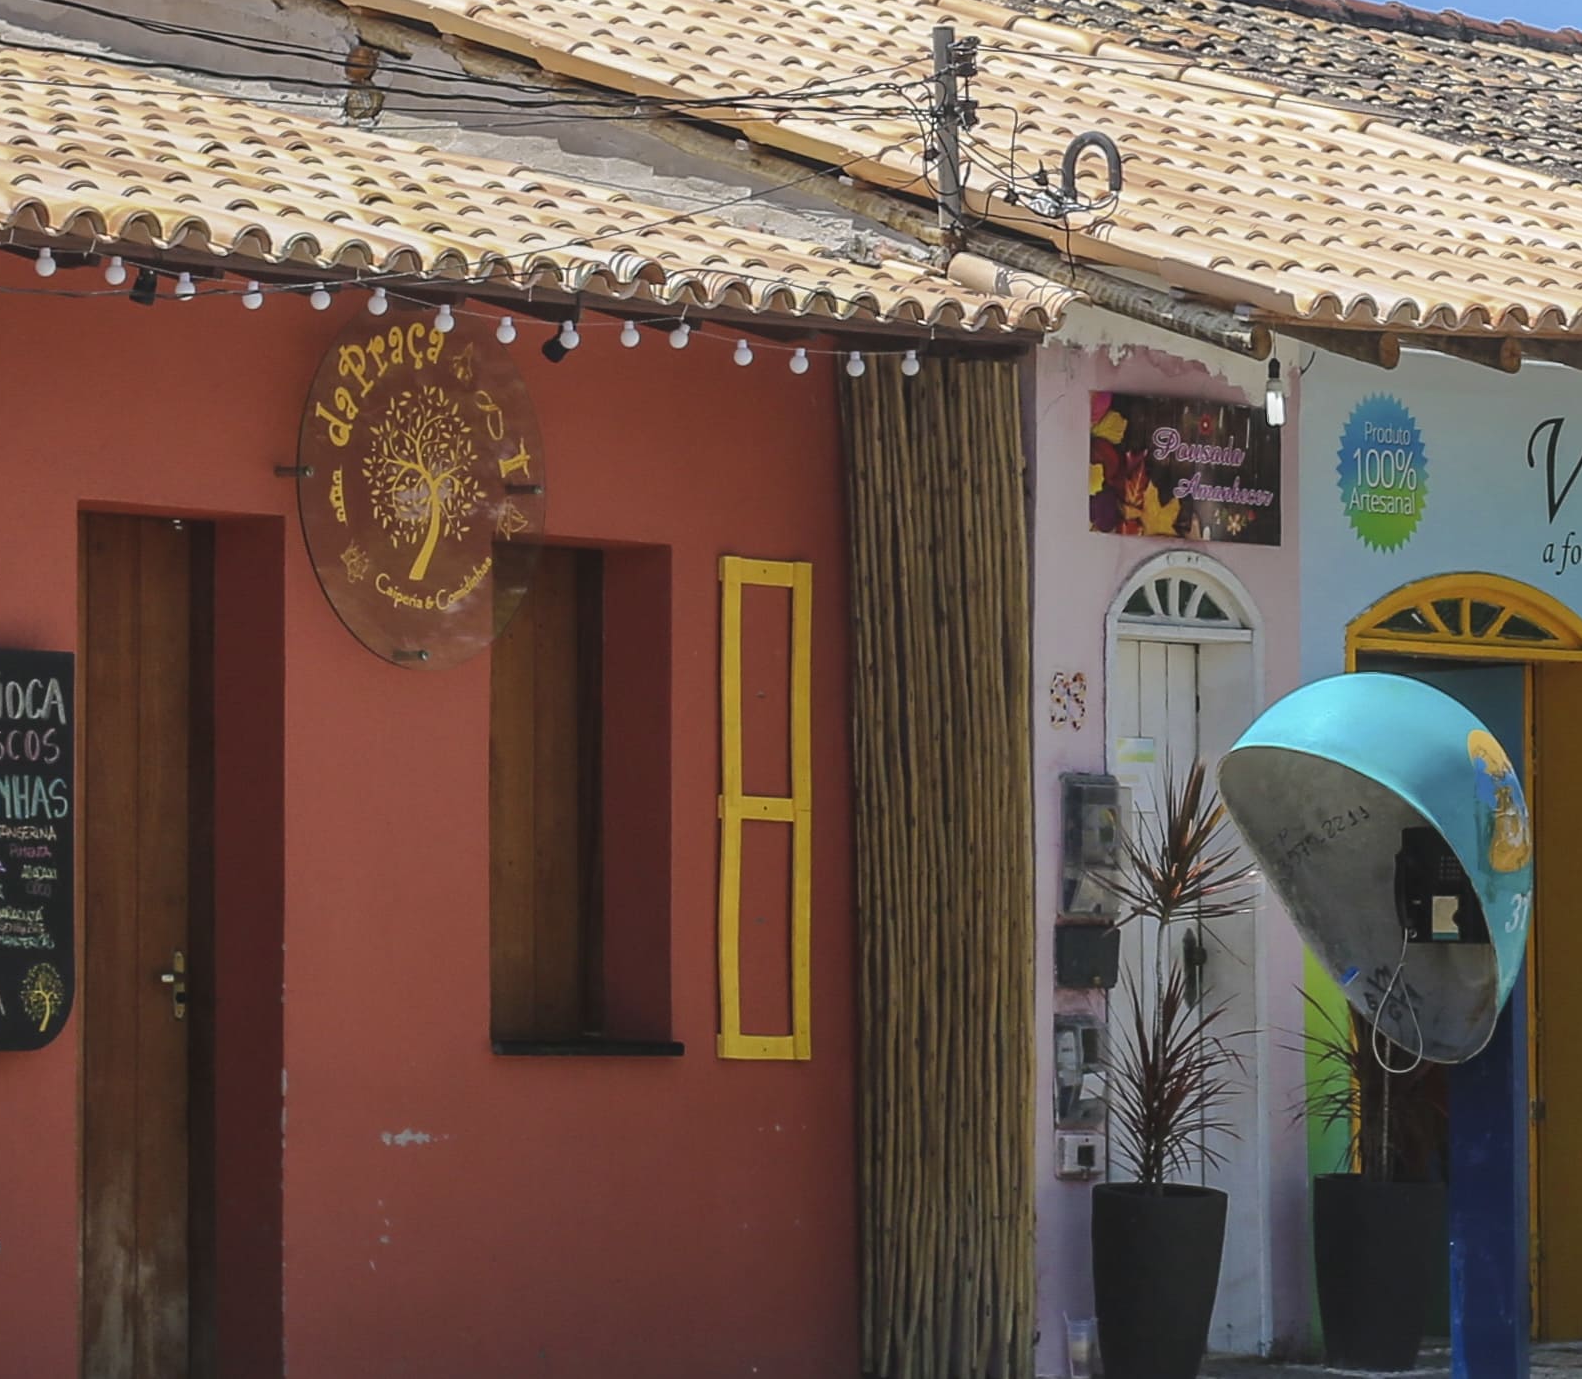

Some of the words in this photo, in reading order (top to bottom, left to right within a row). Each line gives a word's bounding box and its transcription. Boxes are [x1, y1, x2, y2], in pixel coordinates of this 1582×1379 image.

[316, 386, 359, 447] da
[338, 322, 444, 399] Praça
[1152, 426, 1246, 467] Pousada
[1364, 421, 1411, 446] Produto
[1352, 447, 1418, 491] 100%
[1348, 486, 1417, 515] Artesanal
[1542, 541, 1556, 564] a
